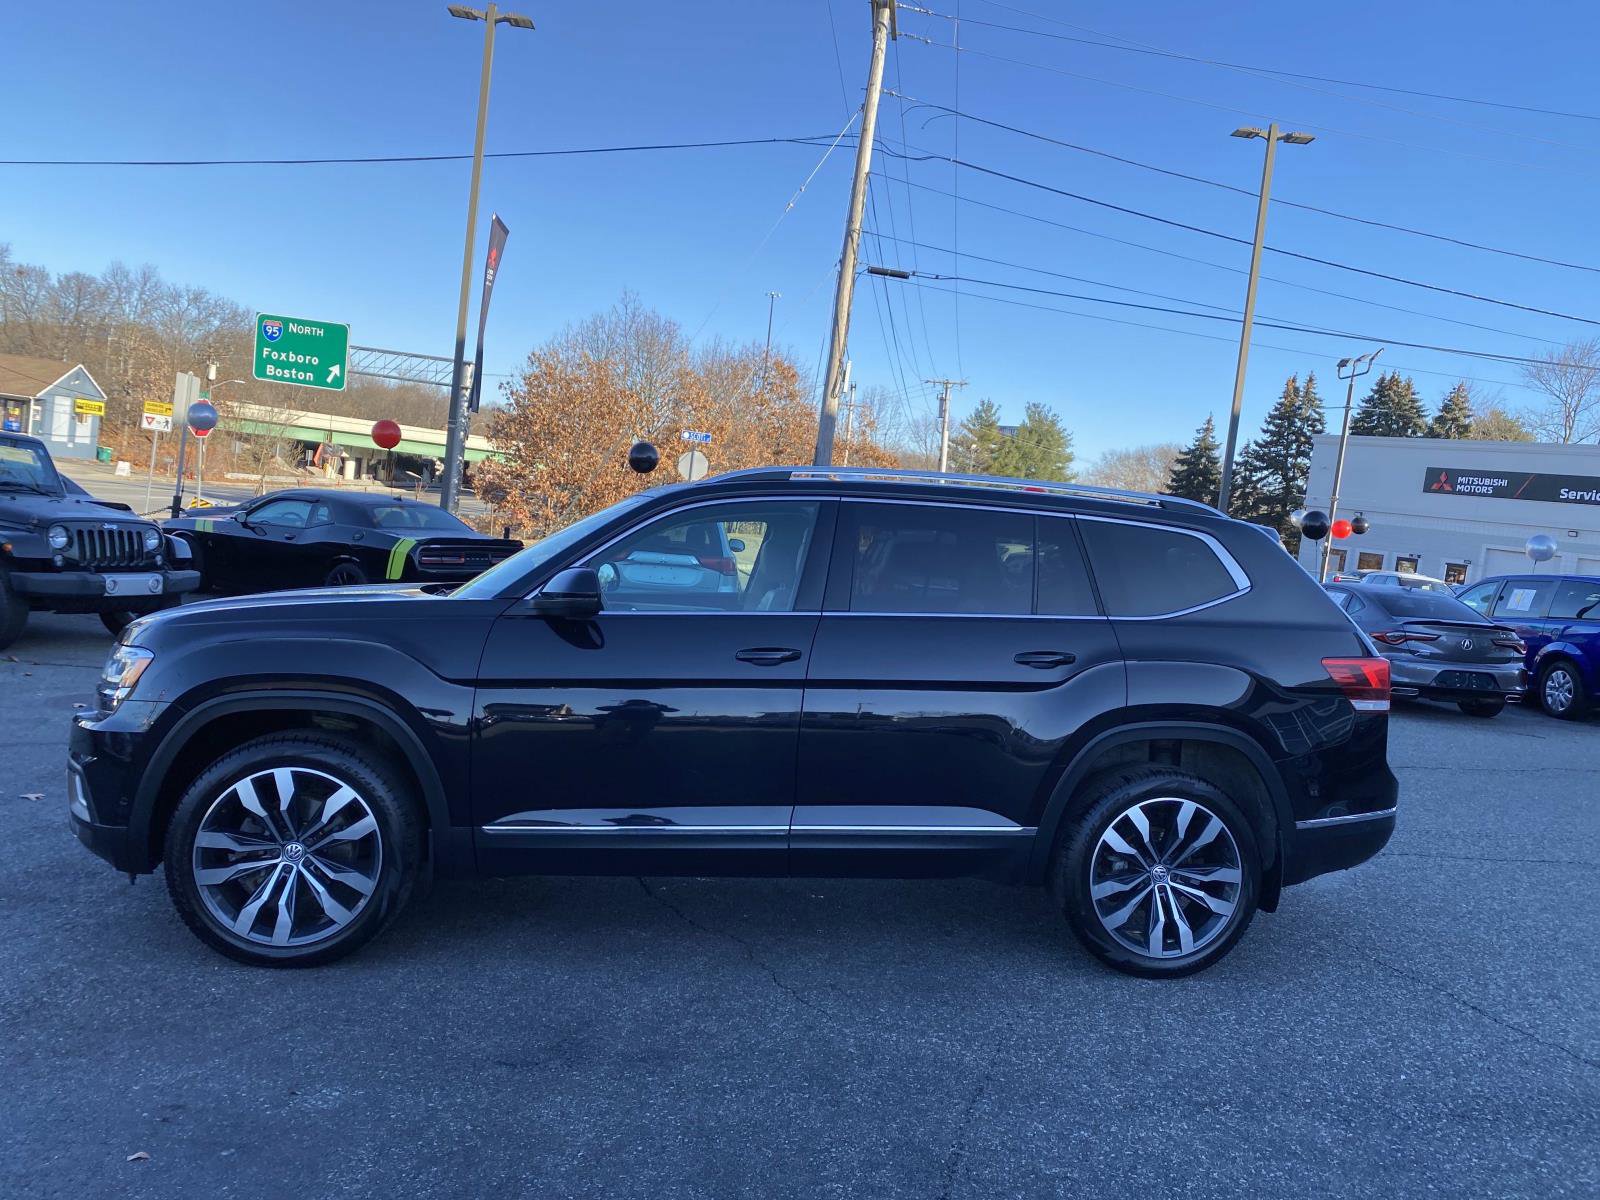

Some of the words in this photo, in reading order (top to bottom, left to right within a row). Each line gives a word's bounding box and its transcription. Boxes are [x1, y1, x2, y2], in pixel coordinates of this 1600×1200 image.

[265, 326, 279, 337] 95
[288, 322, 324, 337] NORTH
[262, 347, 319, 365] Foxboro
[266, 364, 314, 381] Boston
[1457, 476, 1508, 487] MITSUBISHI
[1456, 485, 1493, 494] MOTORS
